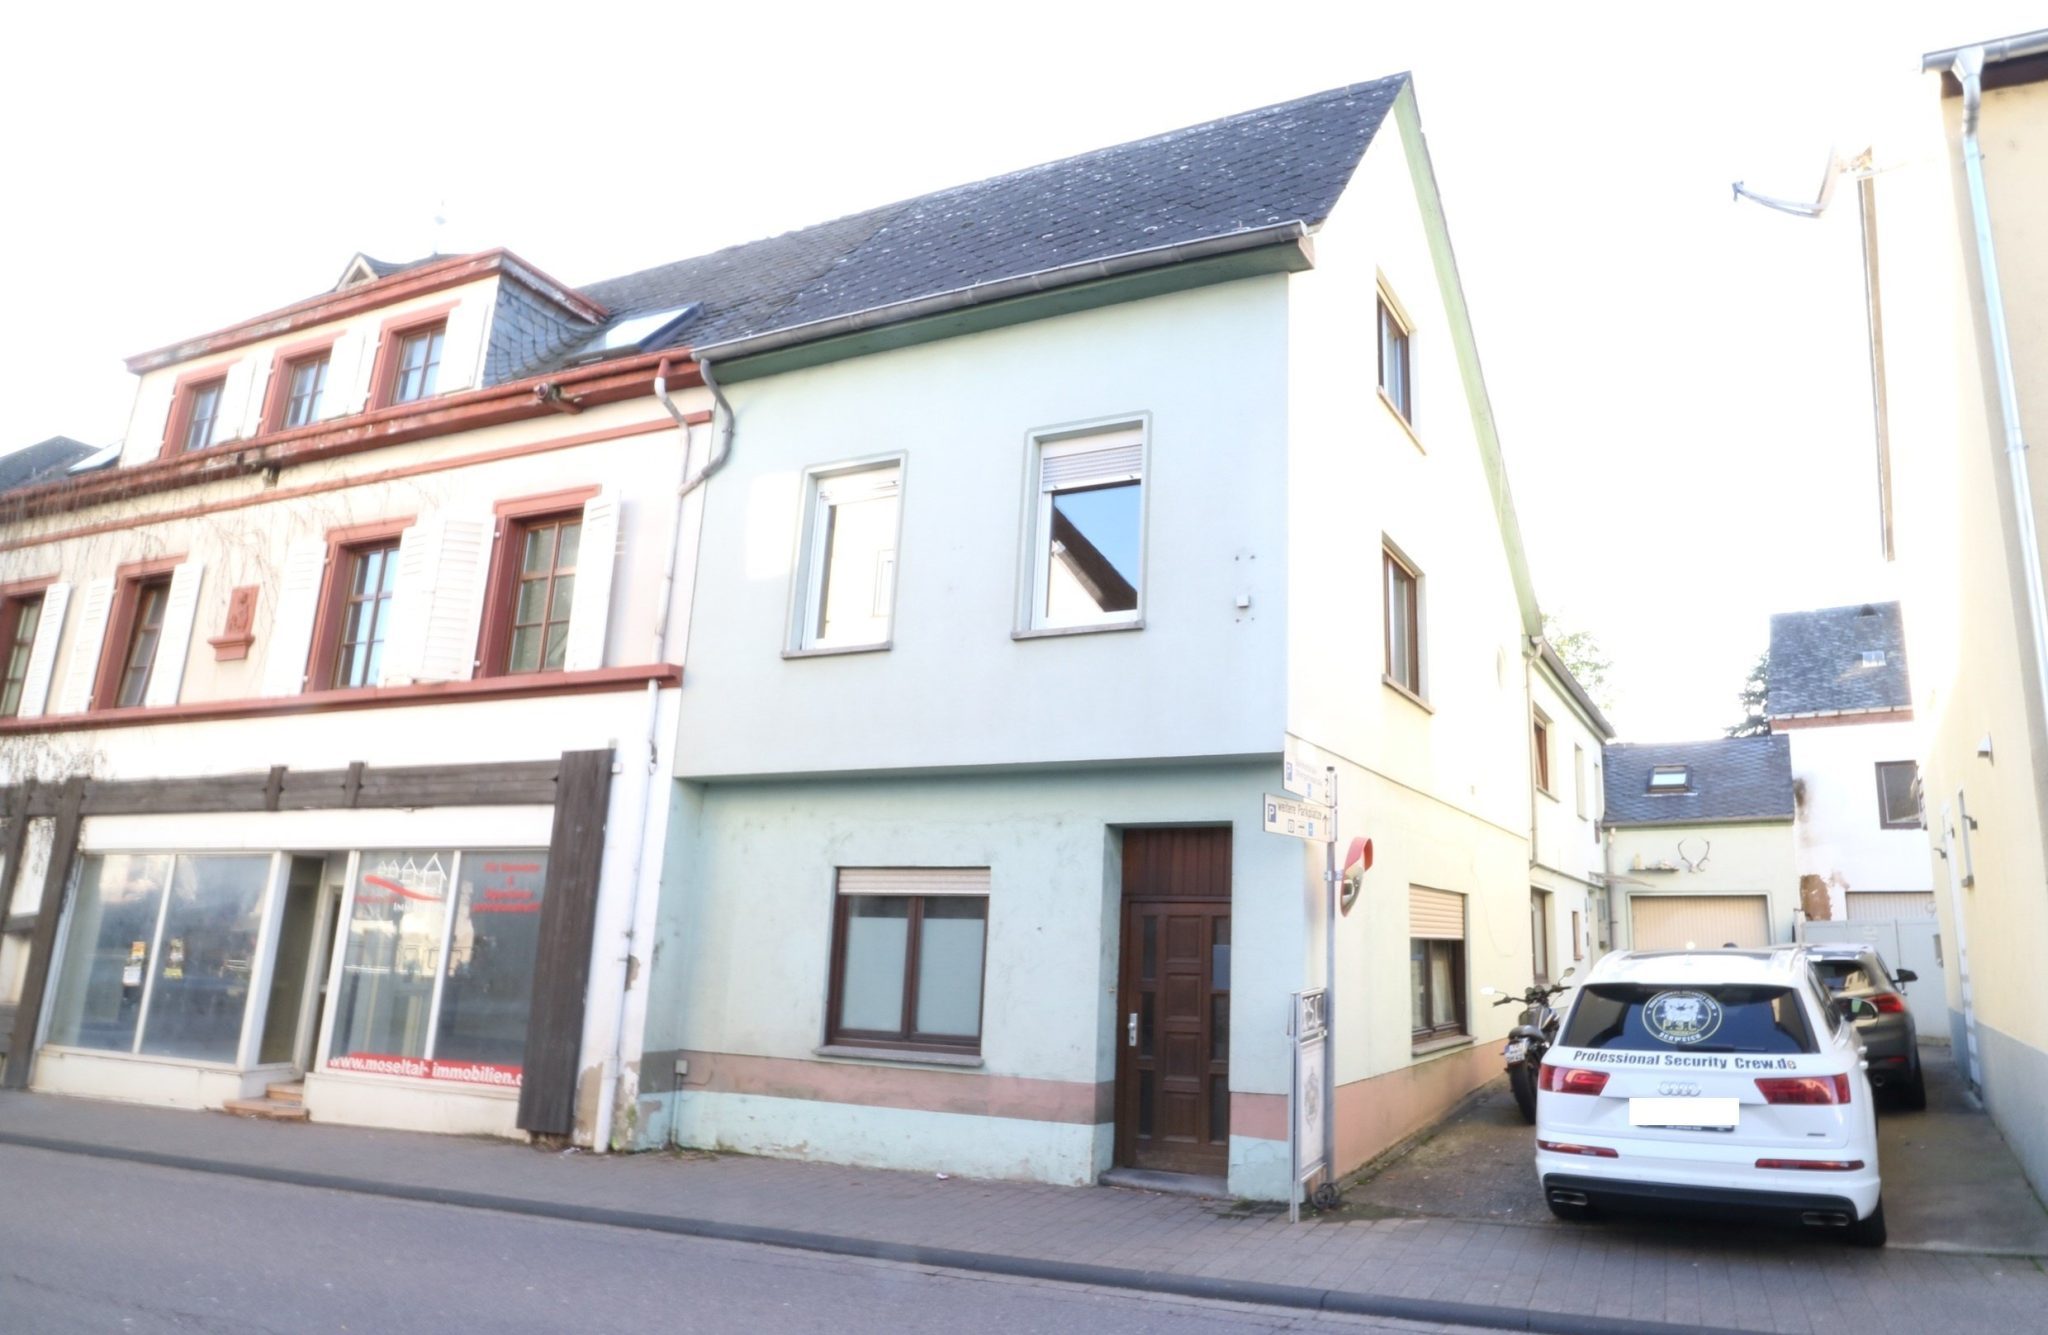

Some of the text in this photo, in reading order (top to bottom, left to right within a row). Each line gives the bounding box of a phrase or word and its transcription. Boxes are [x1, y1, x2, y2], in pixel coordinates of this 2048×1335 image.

[1573, 1050, 1798, 1070] Professional Security Crew.de
